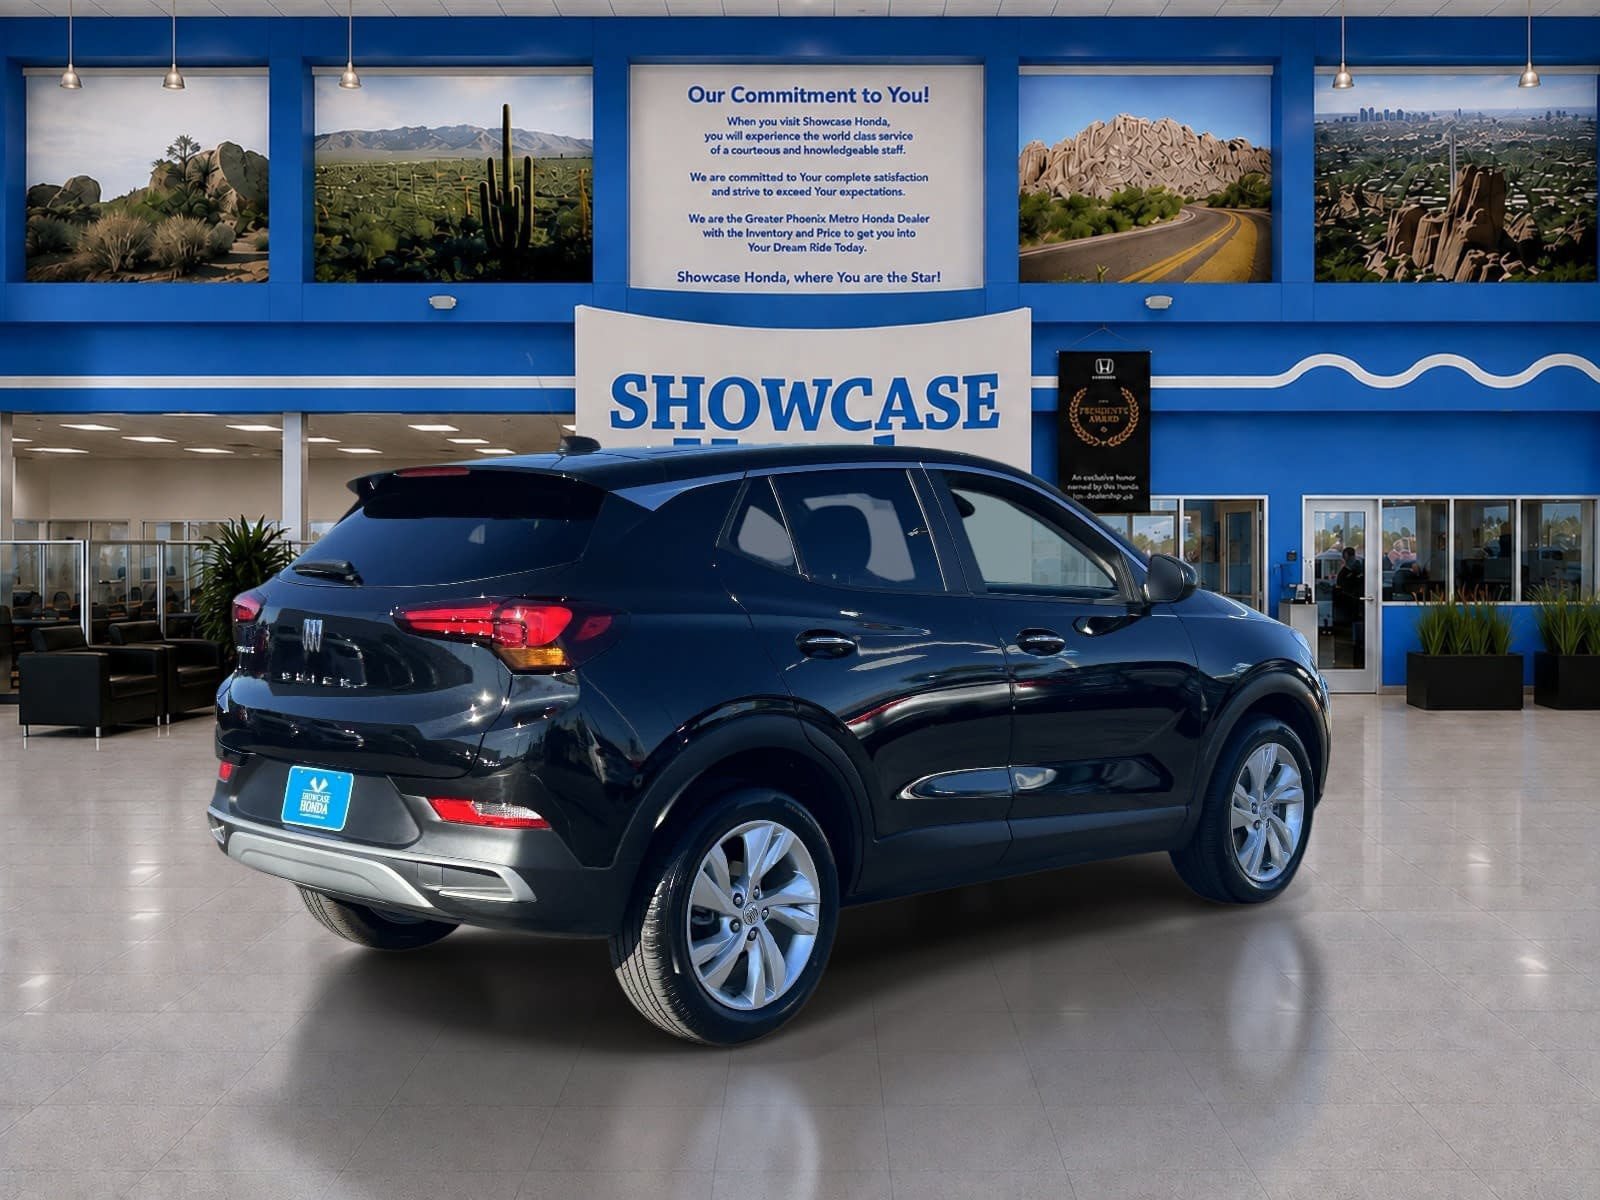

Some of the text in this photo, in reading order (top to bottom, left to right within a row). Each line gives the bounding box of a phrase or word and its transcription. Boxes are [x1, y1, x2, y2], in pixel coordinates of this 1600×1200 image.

[687, 85, 930, 104] Our Commitment to You!
[726, 115, 891, 129] When you visit Showcase Honda,
[704, 130, 914, 144] you will experience the world class service
[709, 144, 722, 155] of
[722, 147, 730, 155] a
[730, 146, 782, 156] courteous
[782, 144, 802, 155] and
[881, 144, 907, 155] staff.
[689, 171, 929, 185] We are committed to Your complete satisfaction
[711, 185, 906, 200] and strive to exceed Your expectations.
[688, 213, 931, 224] We are the Greater Phoenix Metro Honda Dealer
[702, 227, 917, 241] with the Inventory and Price to get you into
[747, 242, 868, 255] Your Dream Ride Today.
[676, 270, 941, 286] Showcase Honda, where You are the Star!
[610, 373, 1000, 430] SHOWCASE
[300, 800, 328, 815] HONDA
